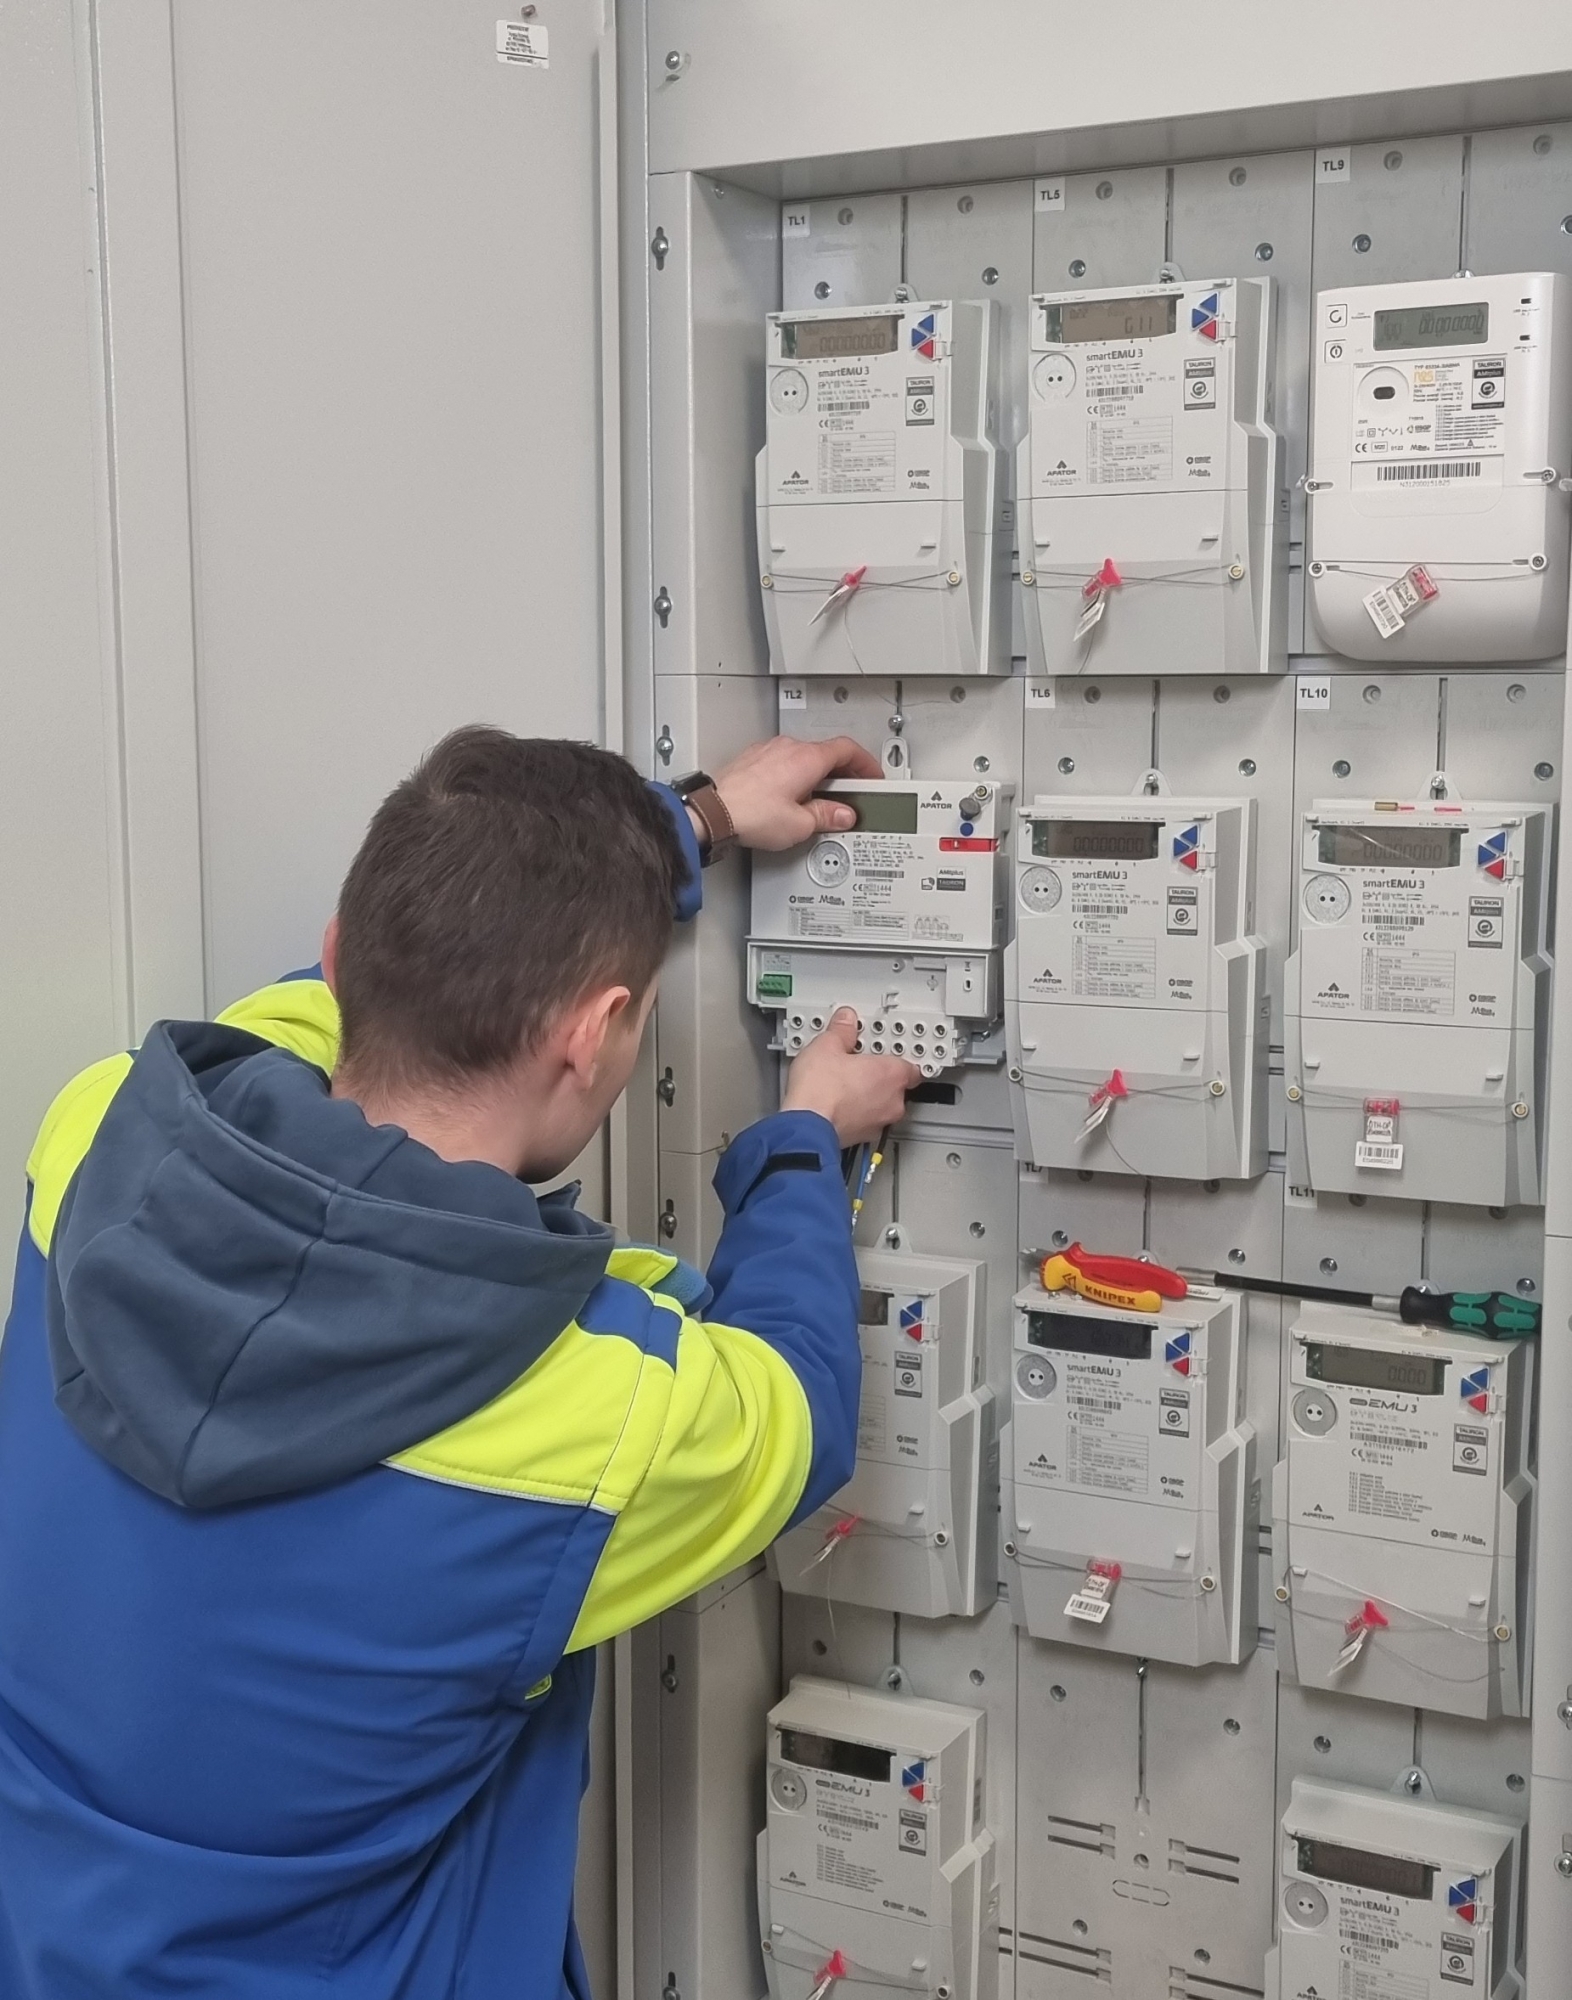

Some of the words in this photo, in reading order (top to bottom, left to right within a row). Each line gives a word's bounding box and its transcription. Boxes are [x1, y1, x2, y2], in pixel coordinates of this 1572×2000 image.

[1323, 160, 1344, 171] TL9
[1041, 190, 1060, 200] TL5
[788, 216, 804, 226] TL1
[1086, 350, 1135, 361] smartEMU
[1137, 349, 1143, 358] 3
[818, 367, 862, 378] smartEMU
[864, 366, 870, 375] 3
[784, 690, 802, 699] TL2
[1031, 688, 1051, 698] TL6
[1300, 688, 1328, 698] TL10
[920, 802, 952, 810] APATOR
[1072, 871, 1120, 880] smartEMU
[1122, 872, 1128, 880] 3
[1363, 879, 1416, 889] smartEMU
[1419, 880, 1425, 889] 3
[1289, 1186, 1315, 1197] TL11
[1085, 1285, 1136, 1306] KNIPEX
[1067, 1364, 1114, 1376] smartEMU
[1115, 1369, 1121, 1378] 3
[1410, 1405, 1417, 1413] 3
[1457, 1427, 1484, 1436] TAURON
[1029, 1462, 1057, 1470] APATOR
[1302, 1511, 1335, 1521] APATOR
[1340, 1897, 1392, 1914] smartEMU
[1394, 1907, 1400, 1916] 3
